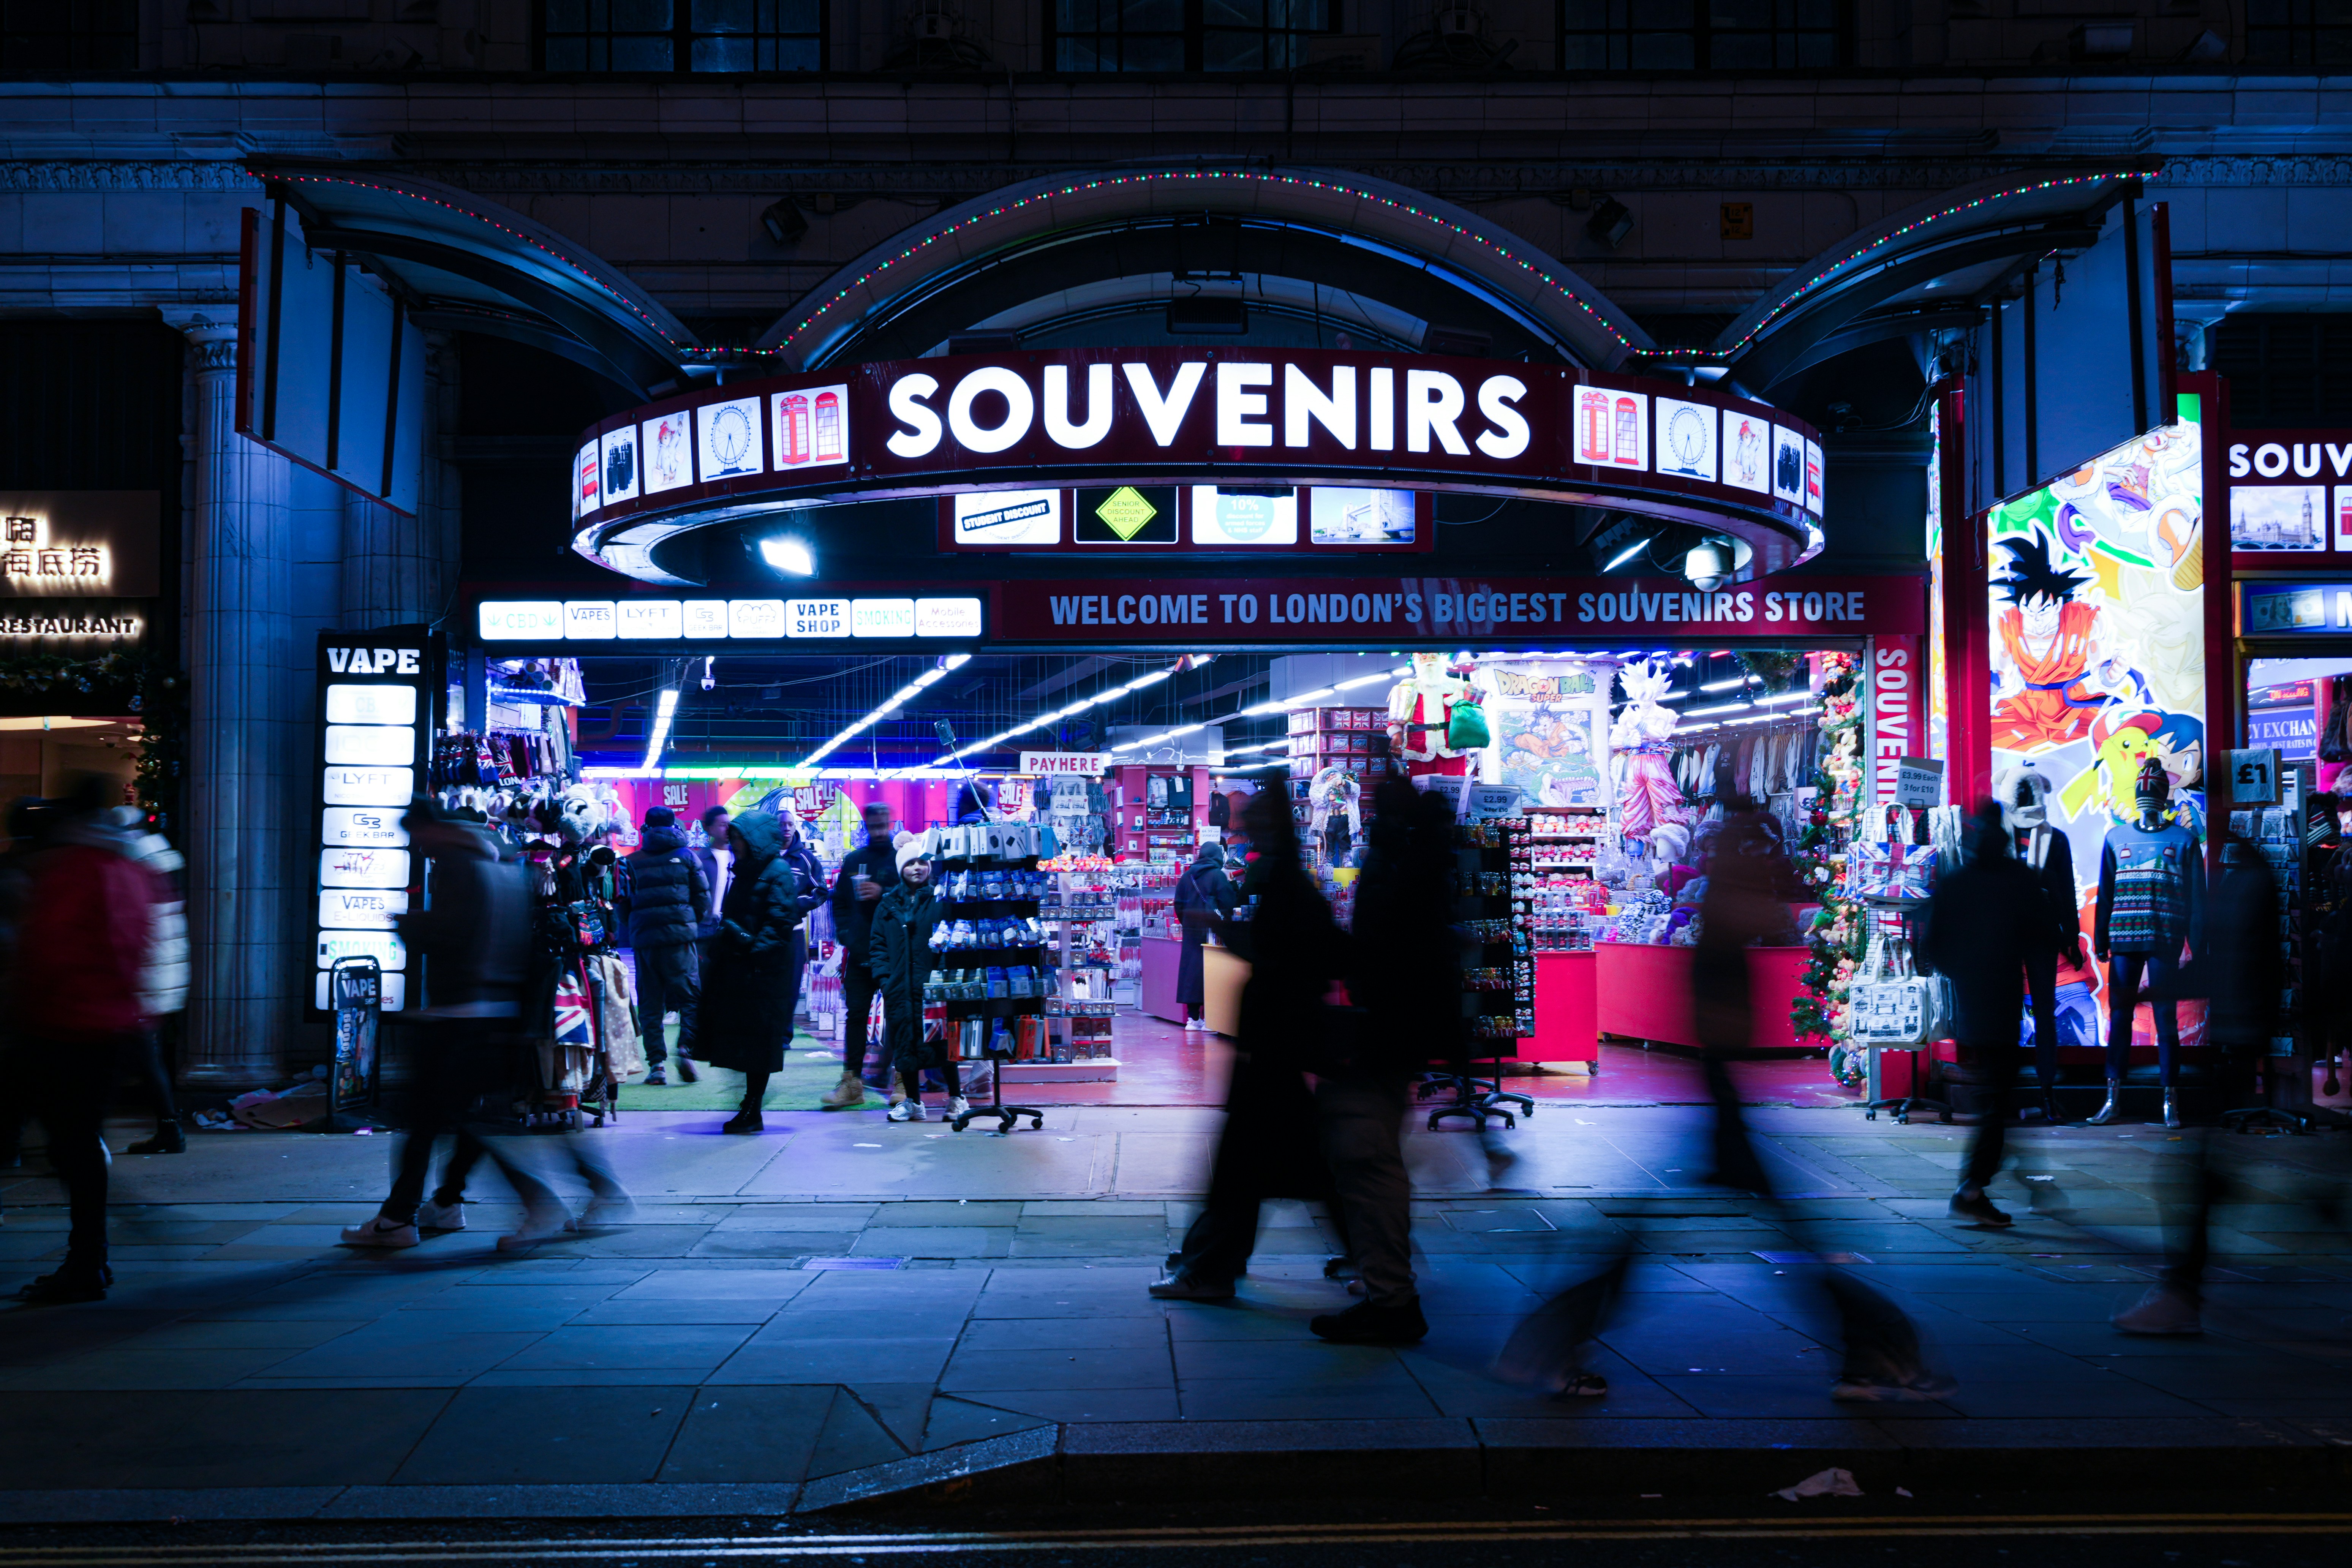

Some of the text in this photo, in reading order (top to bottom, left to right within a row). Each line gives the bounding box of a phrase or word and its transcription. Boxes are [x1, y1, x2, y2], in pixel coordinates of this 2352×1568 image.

[887, 363, 1529, 458] SOUVENIRS
[1231, 499, 1258, 511] 10%
[964, 503, 1046, 529] STUDENT DISCOUNT
[1012, 523, 1032, 539] DISCOUNT
[571, 608, 610, 620] VAPES
[626, 608, 670, 618] LYFT
[797, 604, 839, 616] VAPE
[931, 607, 966, 616] Mobile
[1049, 591, 1864, 625] WELCOME TO LONDON'S BIGGEST SOUVENIRS STORE
[506, 613, 538, 628] CBD
[743, 615, 770, 624] PUFF
[856, 610, 911, 626] SMOKING
[918, 618, 978, 628] Accessories
[797, 620, 841, 632] SHOP
[327, 648, 420, 673] VAPE
[1494, 669, 1595, 695] DRAGON BALL
[1530, 694, 1563, 703] SUPER
[1876, 648, 1908, 804] SOUVENI
[2264, 719, 2316, 738] EXCHAN
[2286, 740, 2305, 749] RATES
[343, 773, 392, 784] LYFT
[1902, 771, 1922, 780] £3.99
[2237, 763, 2267, 784] £1
[663, 784, 688, 805] SALE
[797, 787, 823, 811] SALE
[999, 785, 1022, 805] SALE
[341, 895, 385, 910] VAPES
[334, 911, 394, 922] E-LIQUIDS
[328, 940, 397, 961] SMOKING
[341, 978, 376, 997] VAPE
